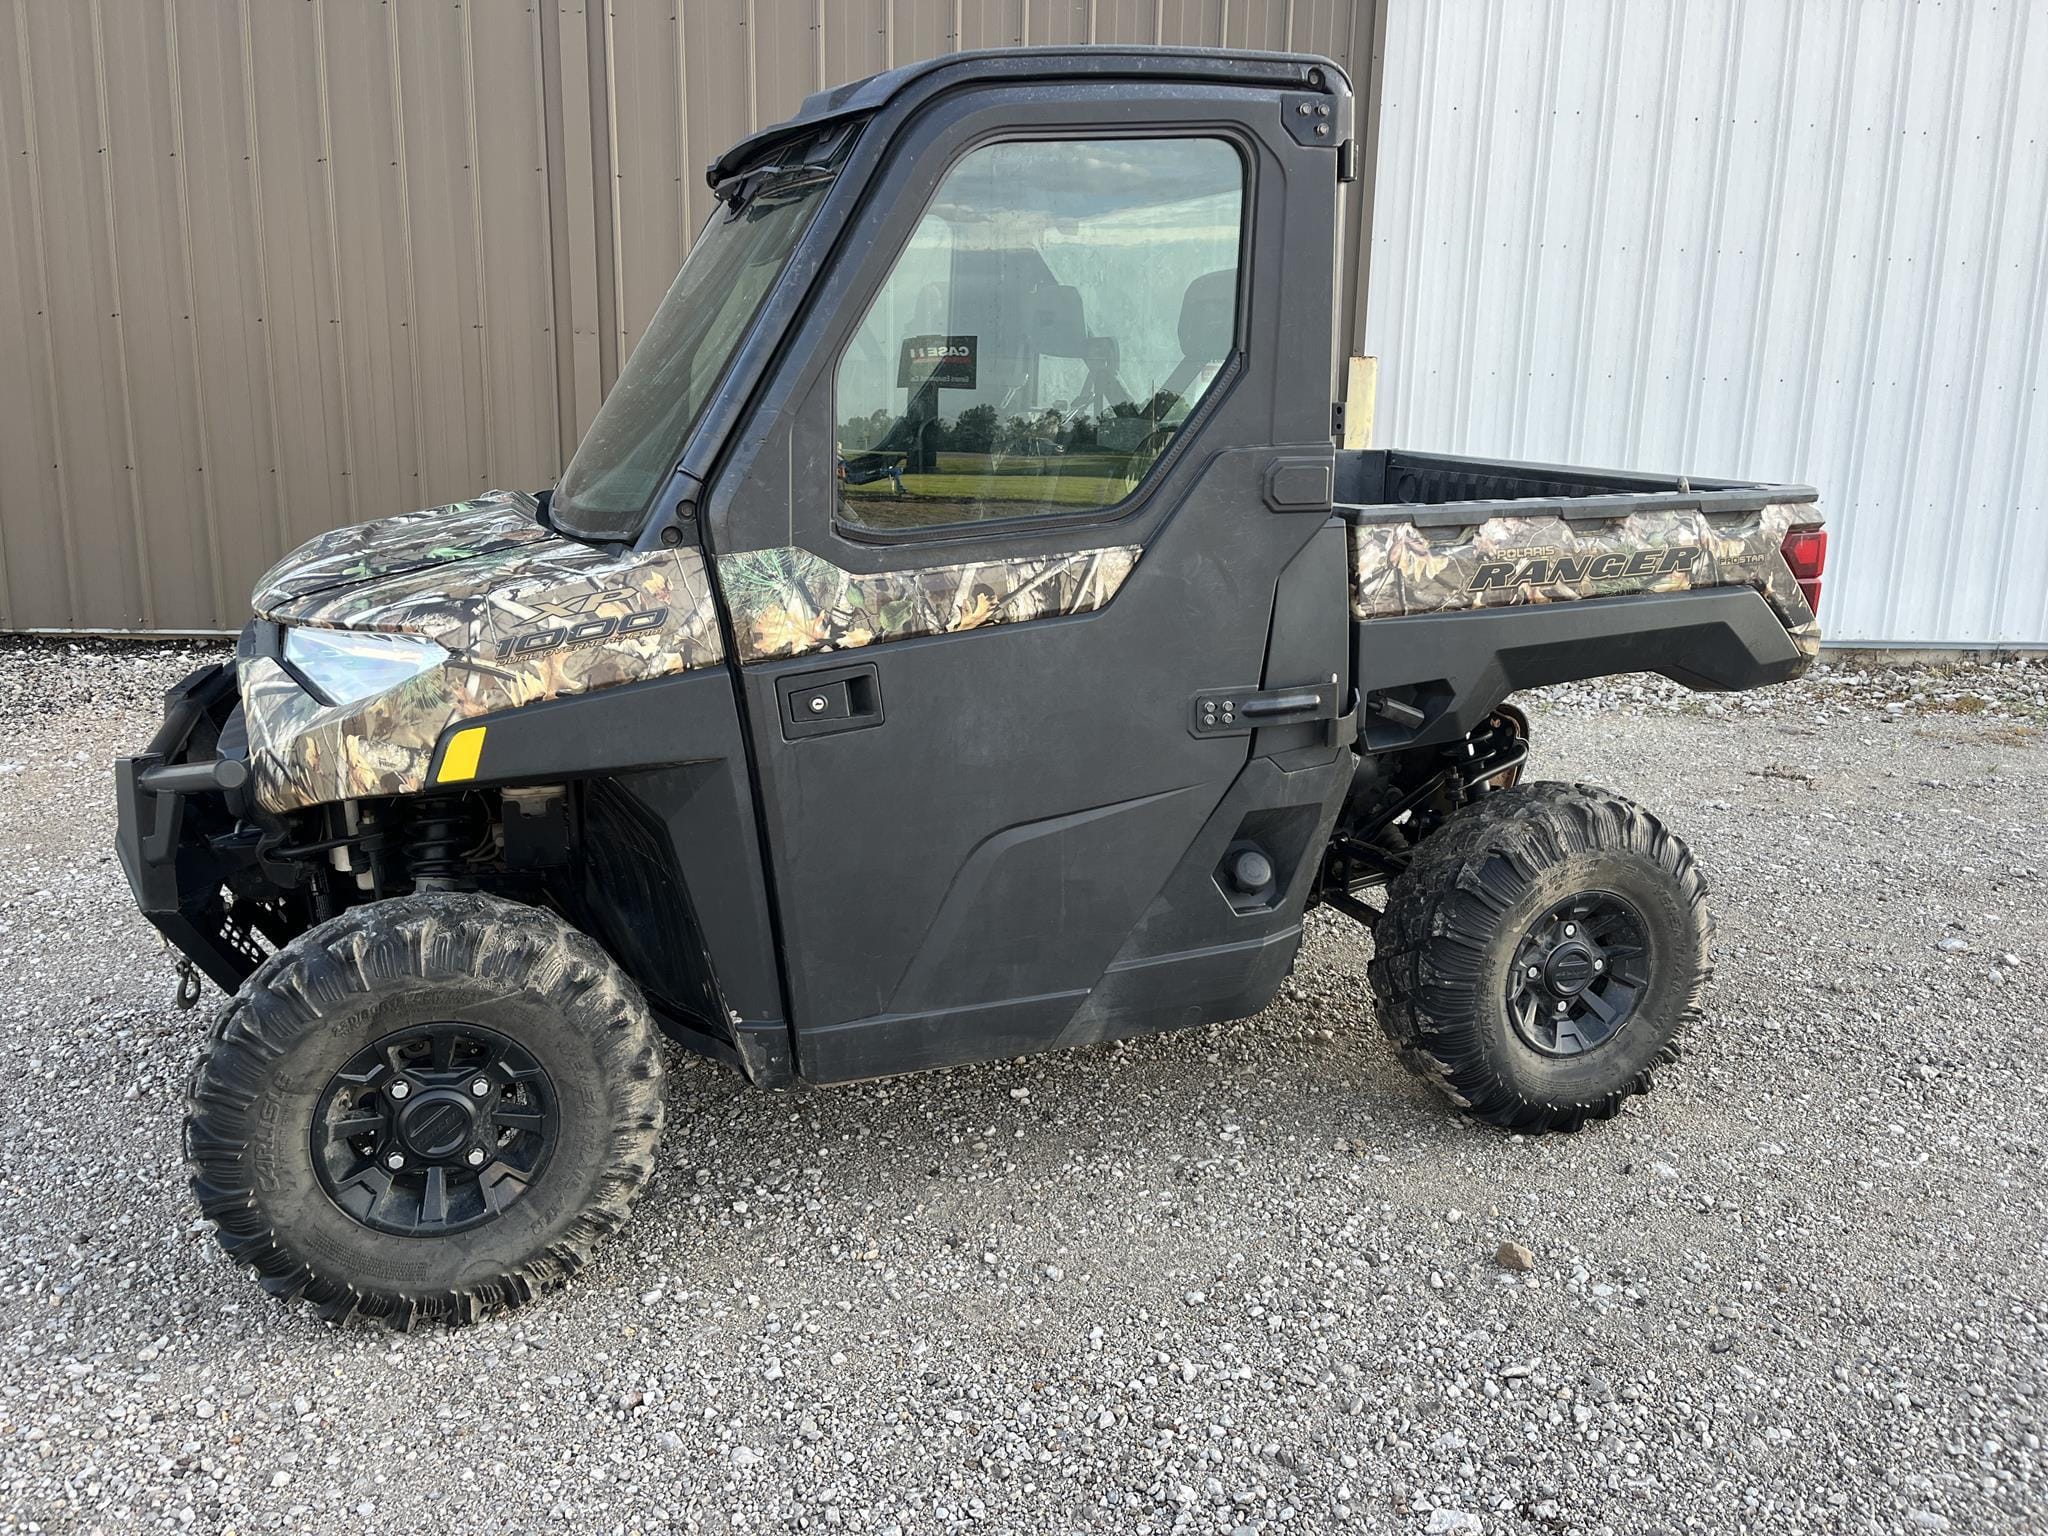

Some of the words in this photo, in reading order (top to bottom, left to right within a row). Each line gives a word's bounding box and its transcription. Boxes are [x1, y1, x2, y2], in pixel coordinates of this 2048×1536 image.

[1497, 545, 1555, 559] POLARIS
[1719, 554, 1765, 565] PROSTAR
[1466, 545, 1702, 592] RANGER
[511, 586, 639, 628] XP
[494, 606, 668, 660] 1000
[495, 651, 540, 667] DUAL
